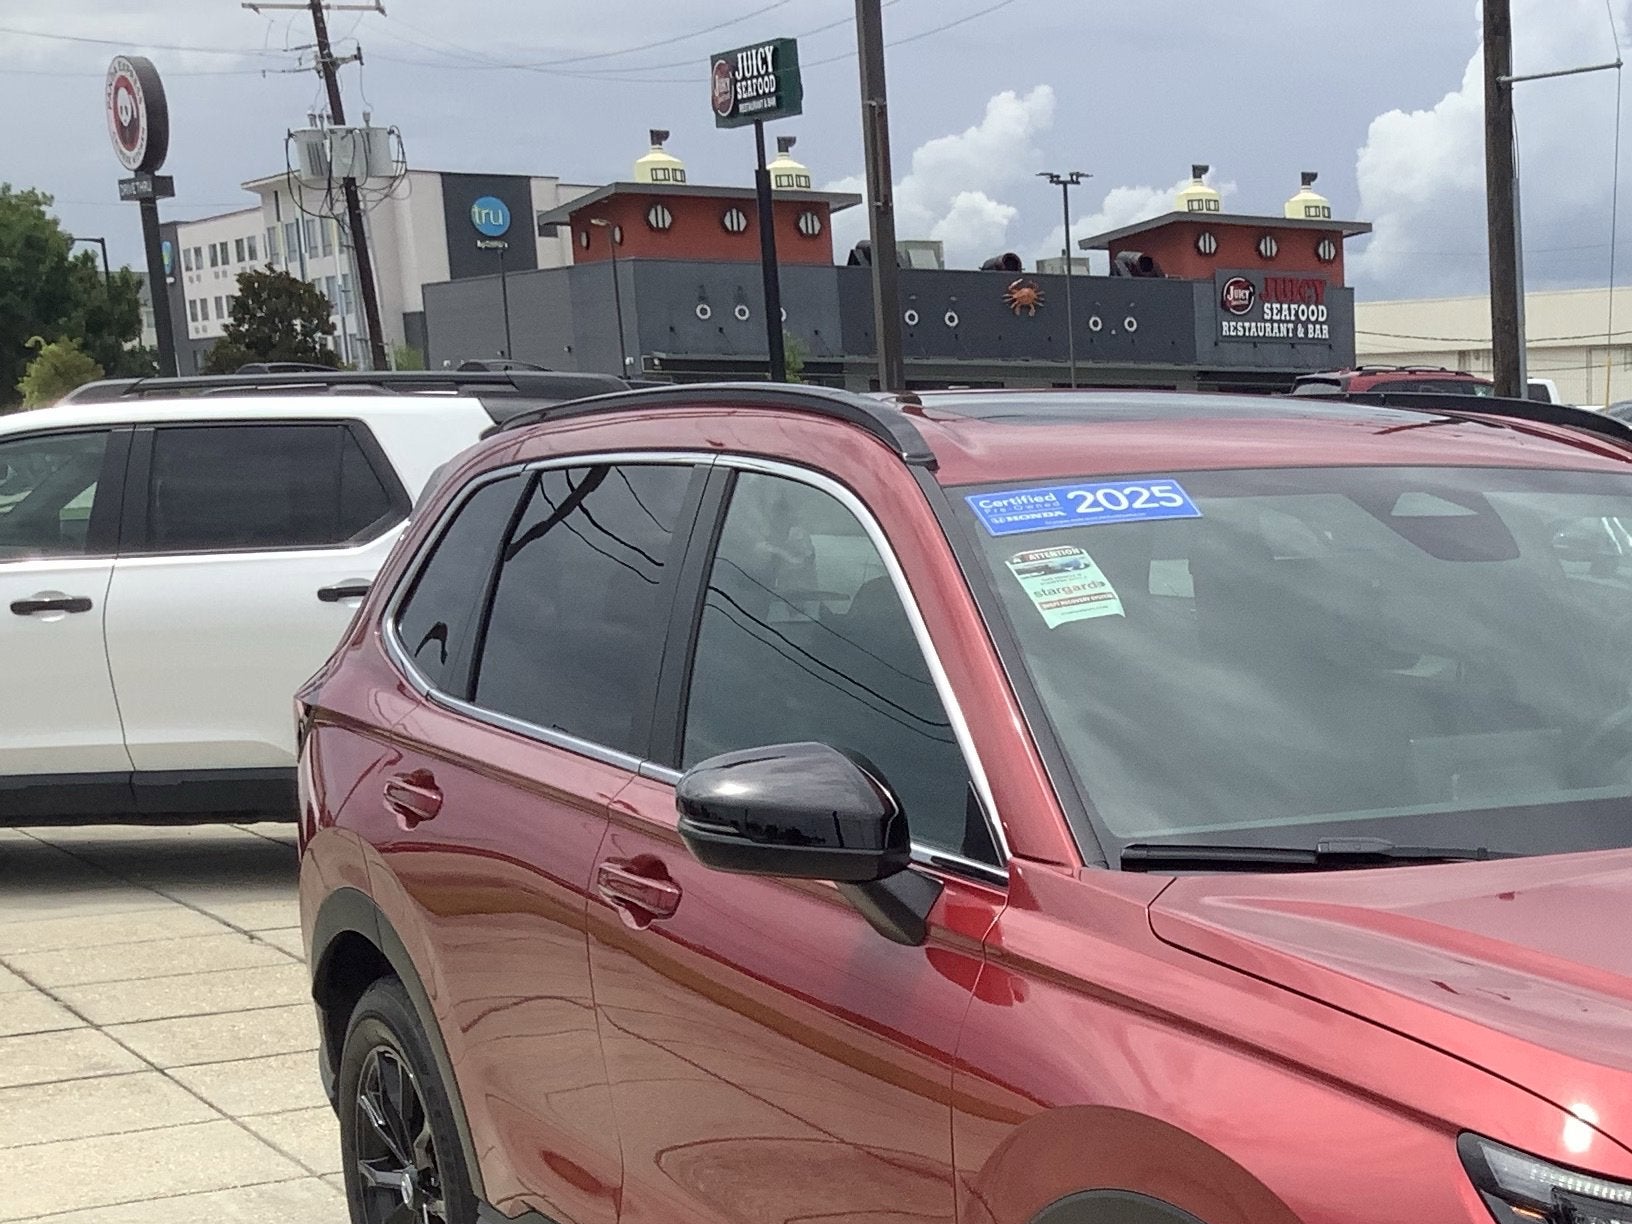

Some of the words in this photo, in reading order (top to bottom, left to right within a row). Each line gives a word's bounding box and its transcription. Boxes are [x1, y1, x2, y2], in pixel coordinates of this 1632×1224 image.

[735, 45, 774, 80] JUICY
[736, 74, 776, 100] SEAFOOD
[472, 204, 504, 225] tru
[1227, 285, 1250, 300] JUICY
[1259, 277, 1326, 304] JUICY
[1263, 303, 1327, 321] SEAFOOD
[1222, 321, 1294, 338] RESTAURANT
[1297, 323, 1305, 338] &
[1307, 324, 1329, 339] BAR
[979, 492, 1057, 509] Certified
[1067, 486, 1184, 514] 2025
[1006, 510, 1067, 523] HONDA
[1028, 547, 1080, 561] ATTENTION
